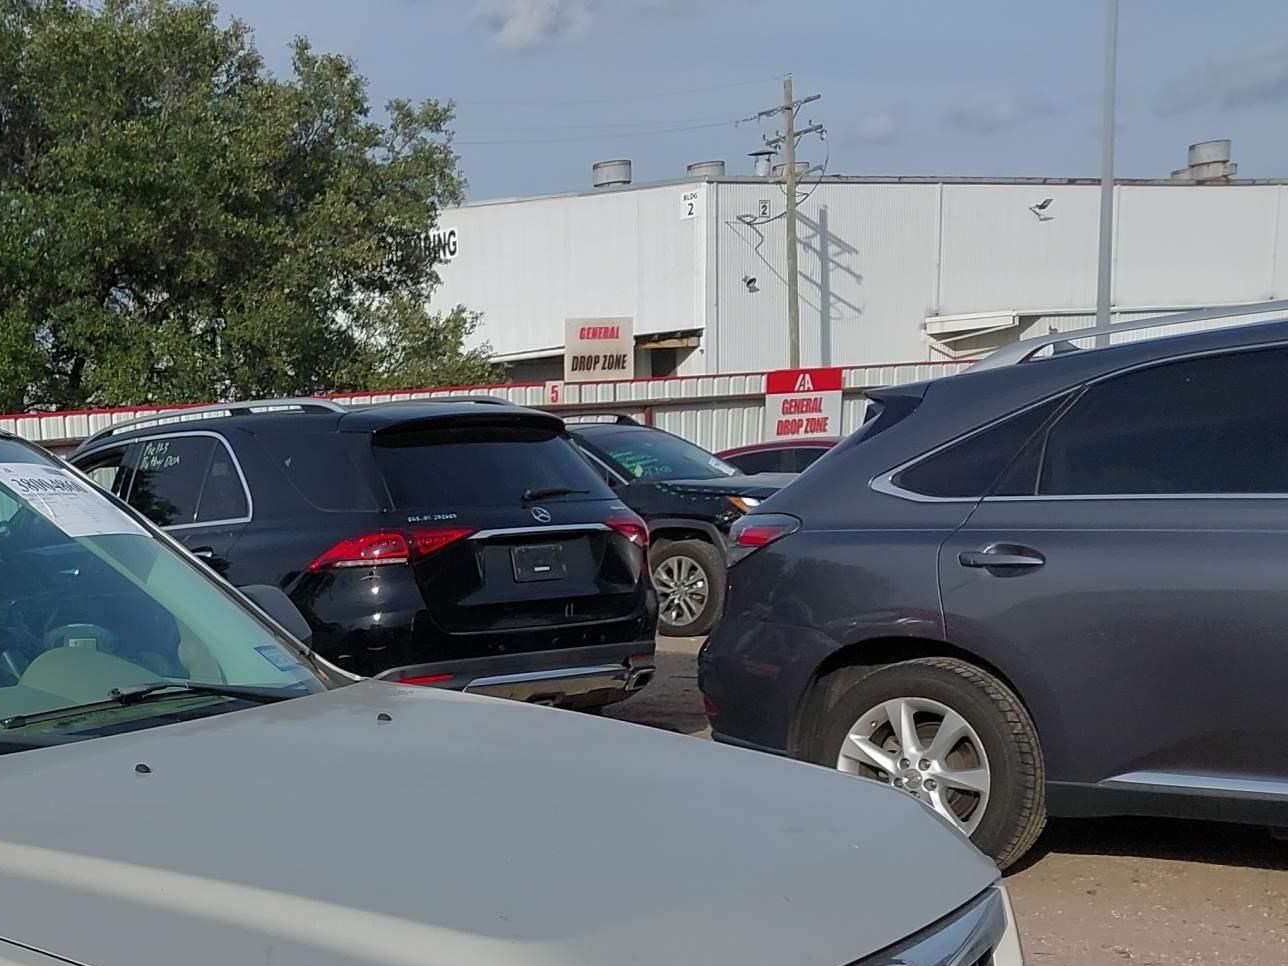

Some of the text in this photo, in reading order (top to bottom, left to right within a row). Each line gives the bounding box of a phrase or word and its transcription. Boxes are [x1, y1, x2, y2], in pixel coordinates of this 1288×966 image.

[687, 203, 695, 216] 2
[761, 204, 768, 215] 2
[579, 326, 620, 340] GENERAL
[571, 353, 628, 371] DROP ZONE
[551, 385, 558, 403] 5
[782, 397, 823, 415] GENERAL
[776, 417, 829, 436] DROP ZONE
